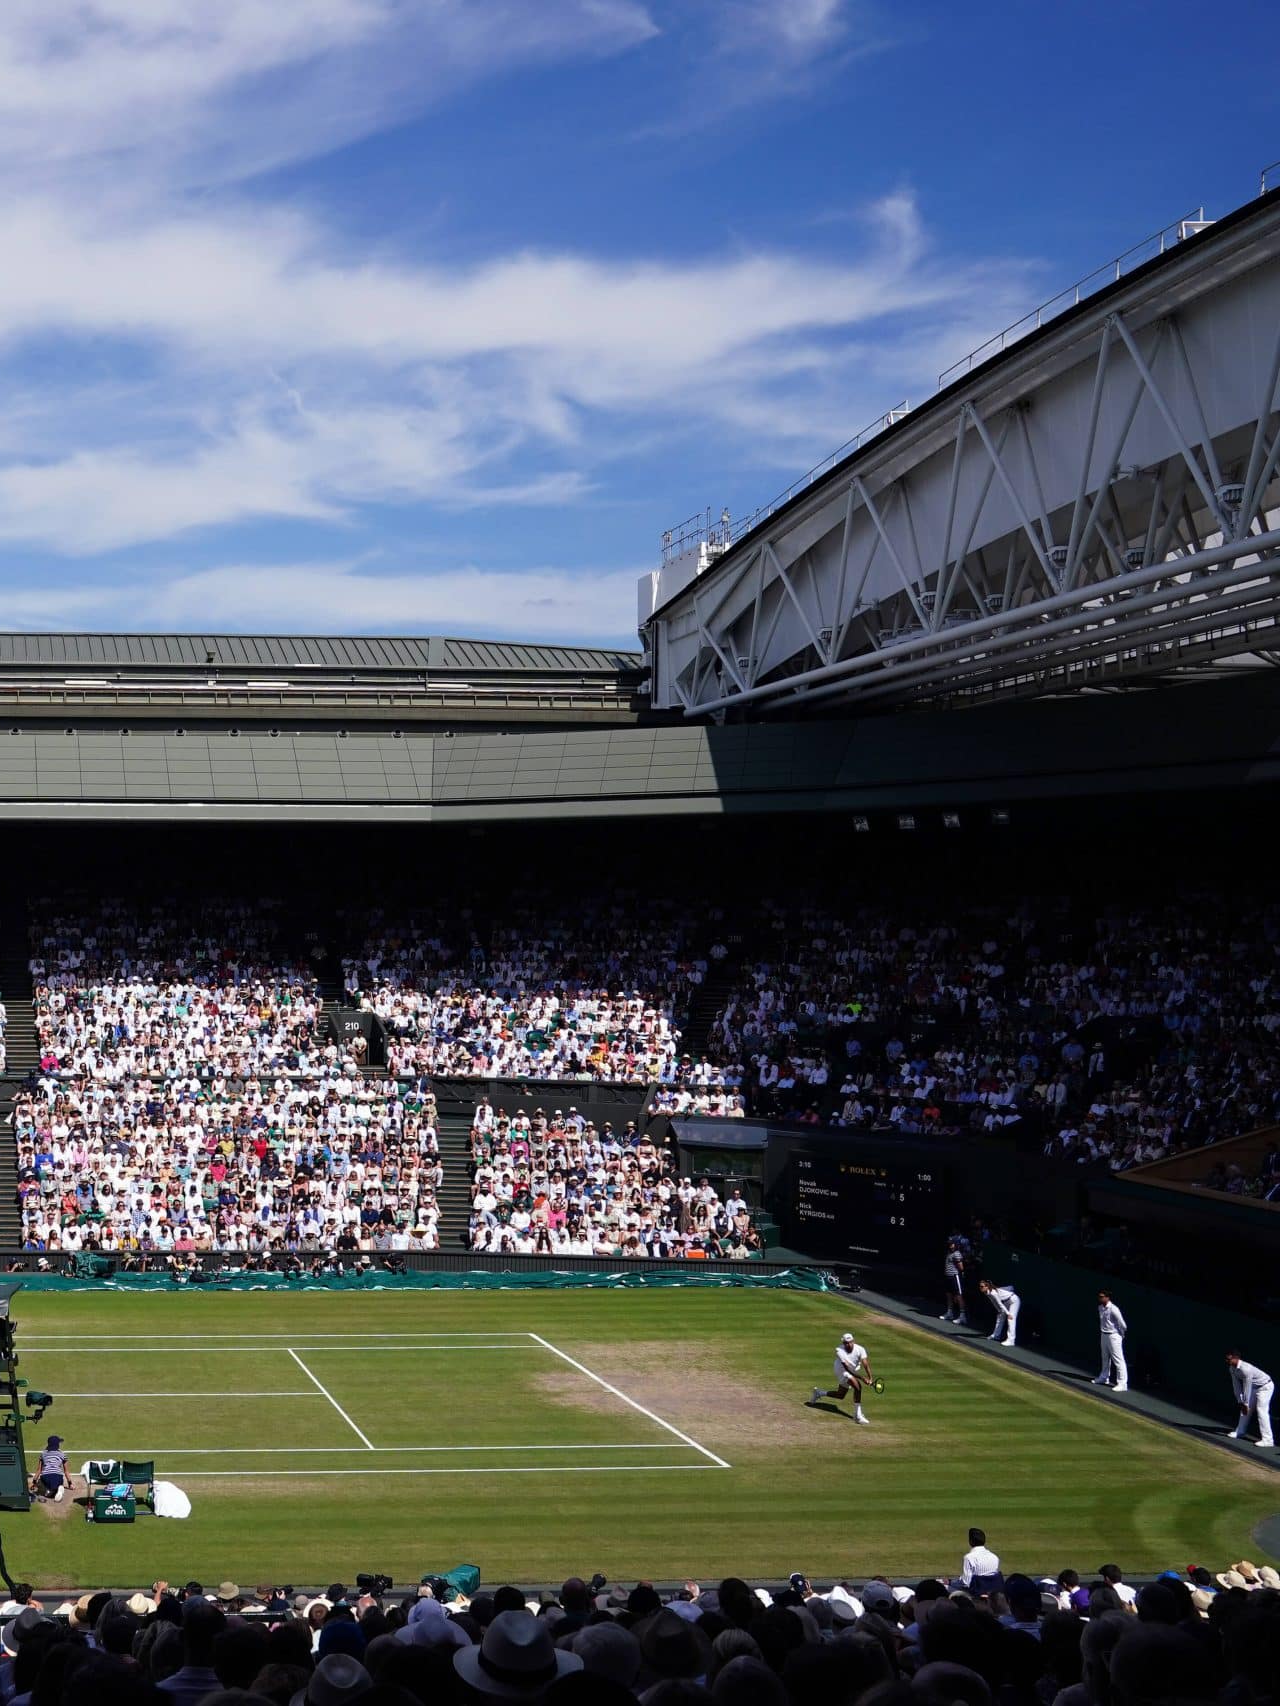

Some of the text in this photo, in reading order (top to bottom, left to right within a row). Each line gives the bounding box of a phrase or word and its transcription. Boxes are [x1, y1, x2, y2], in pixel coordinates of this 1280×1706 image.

[344, 1022, 360, 1031] 210
[849, 1166, 876, 1176] ROLEX
[799, 1186, 830, 1197] DJOKOVIC
[799, 1209, 826, 1219] KYRGIOS
